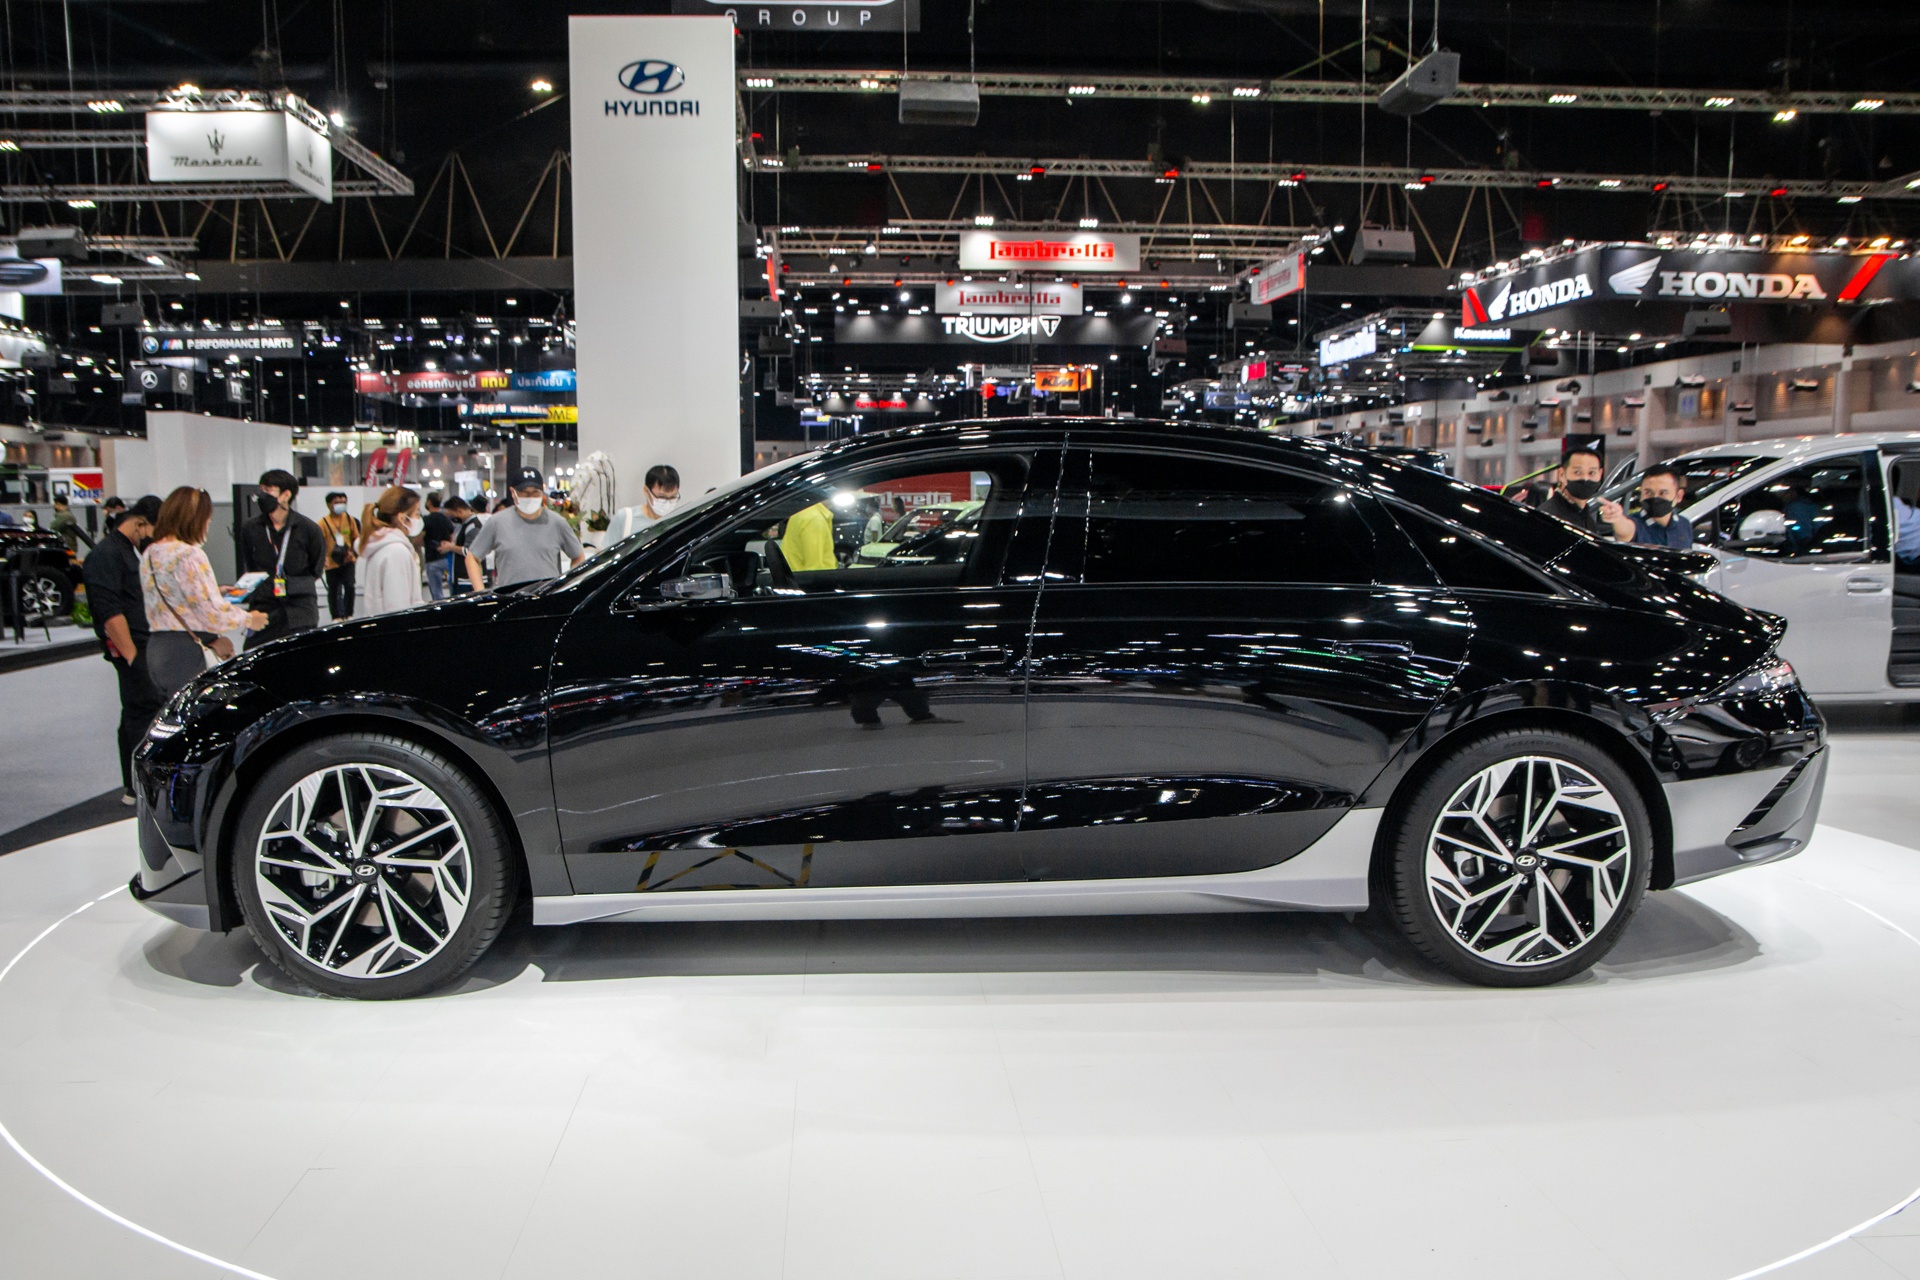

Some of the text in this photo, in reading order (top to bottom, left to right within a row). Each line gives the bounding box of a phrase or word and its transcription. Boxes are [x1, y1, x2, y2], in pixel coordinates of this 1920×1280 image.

[605, 100, 699, 116] HYUNDAI
[171, 155, 262, 167] Maserati
[1508, 273, 1593, 316] HONDA
[1657, 271, 1827, 300] HONDA
[942, 316, 1038, 343] TRIUMPH
[187, 338, 260, 349] PERFORMANCE
[261, 338, 294, 349] PARTS
